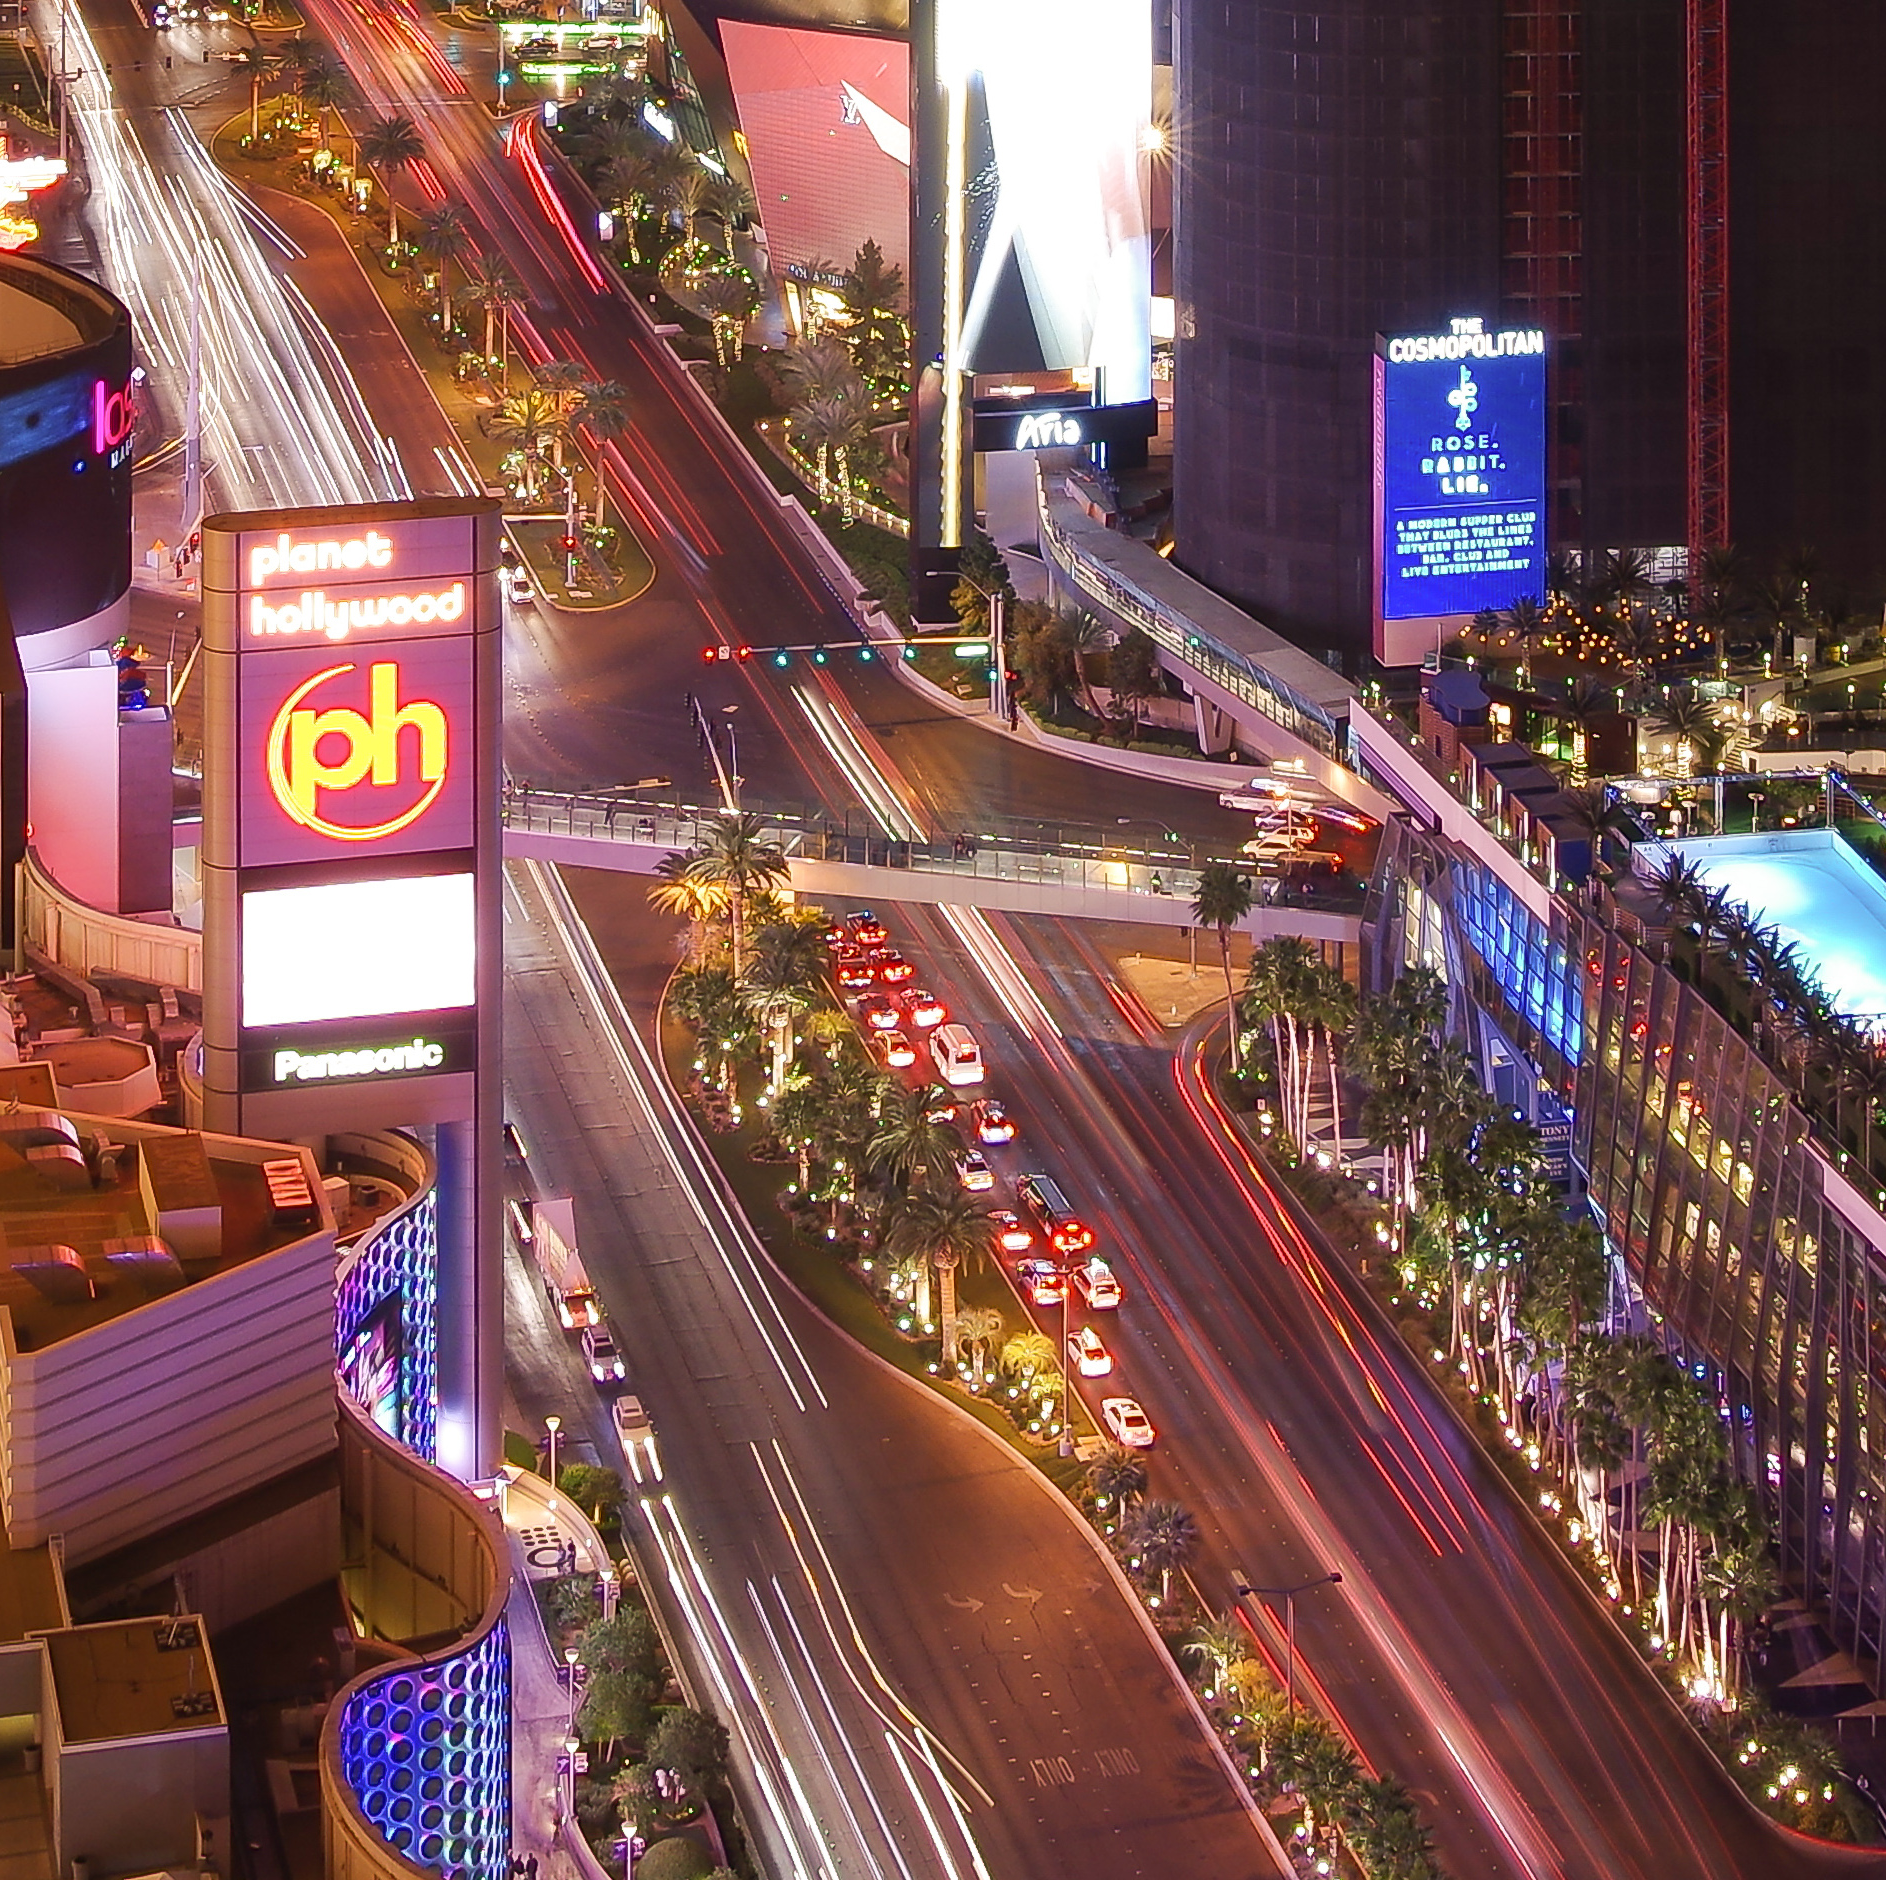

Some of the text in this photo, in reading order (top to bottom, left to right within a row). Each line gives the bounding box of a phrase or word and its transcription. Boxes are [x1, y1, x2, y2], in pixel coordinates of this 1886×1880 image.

[1389, 330, 1545, 363] COSMOPOLITAN
[1450, 317, 1484, 335] THE
[1016, 413, 1082, 452] Aria
[249, 531, 393, 589] planet
[250, 582, 466, 640] hollywood
[289, 663, 448, 826] ph
[274, 1038, 446, 1082] Panasonic
[1540, 1125, 1570, 1136] TONY
